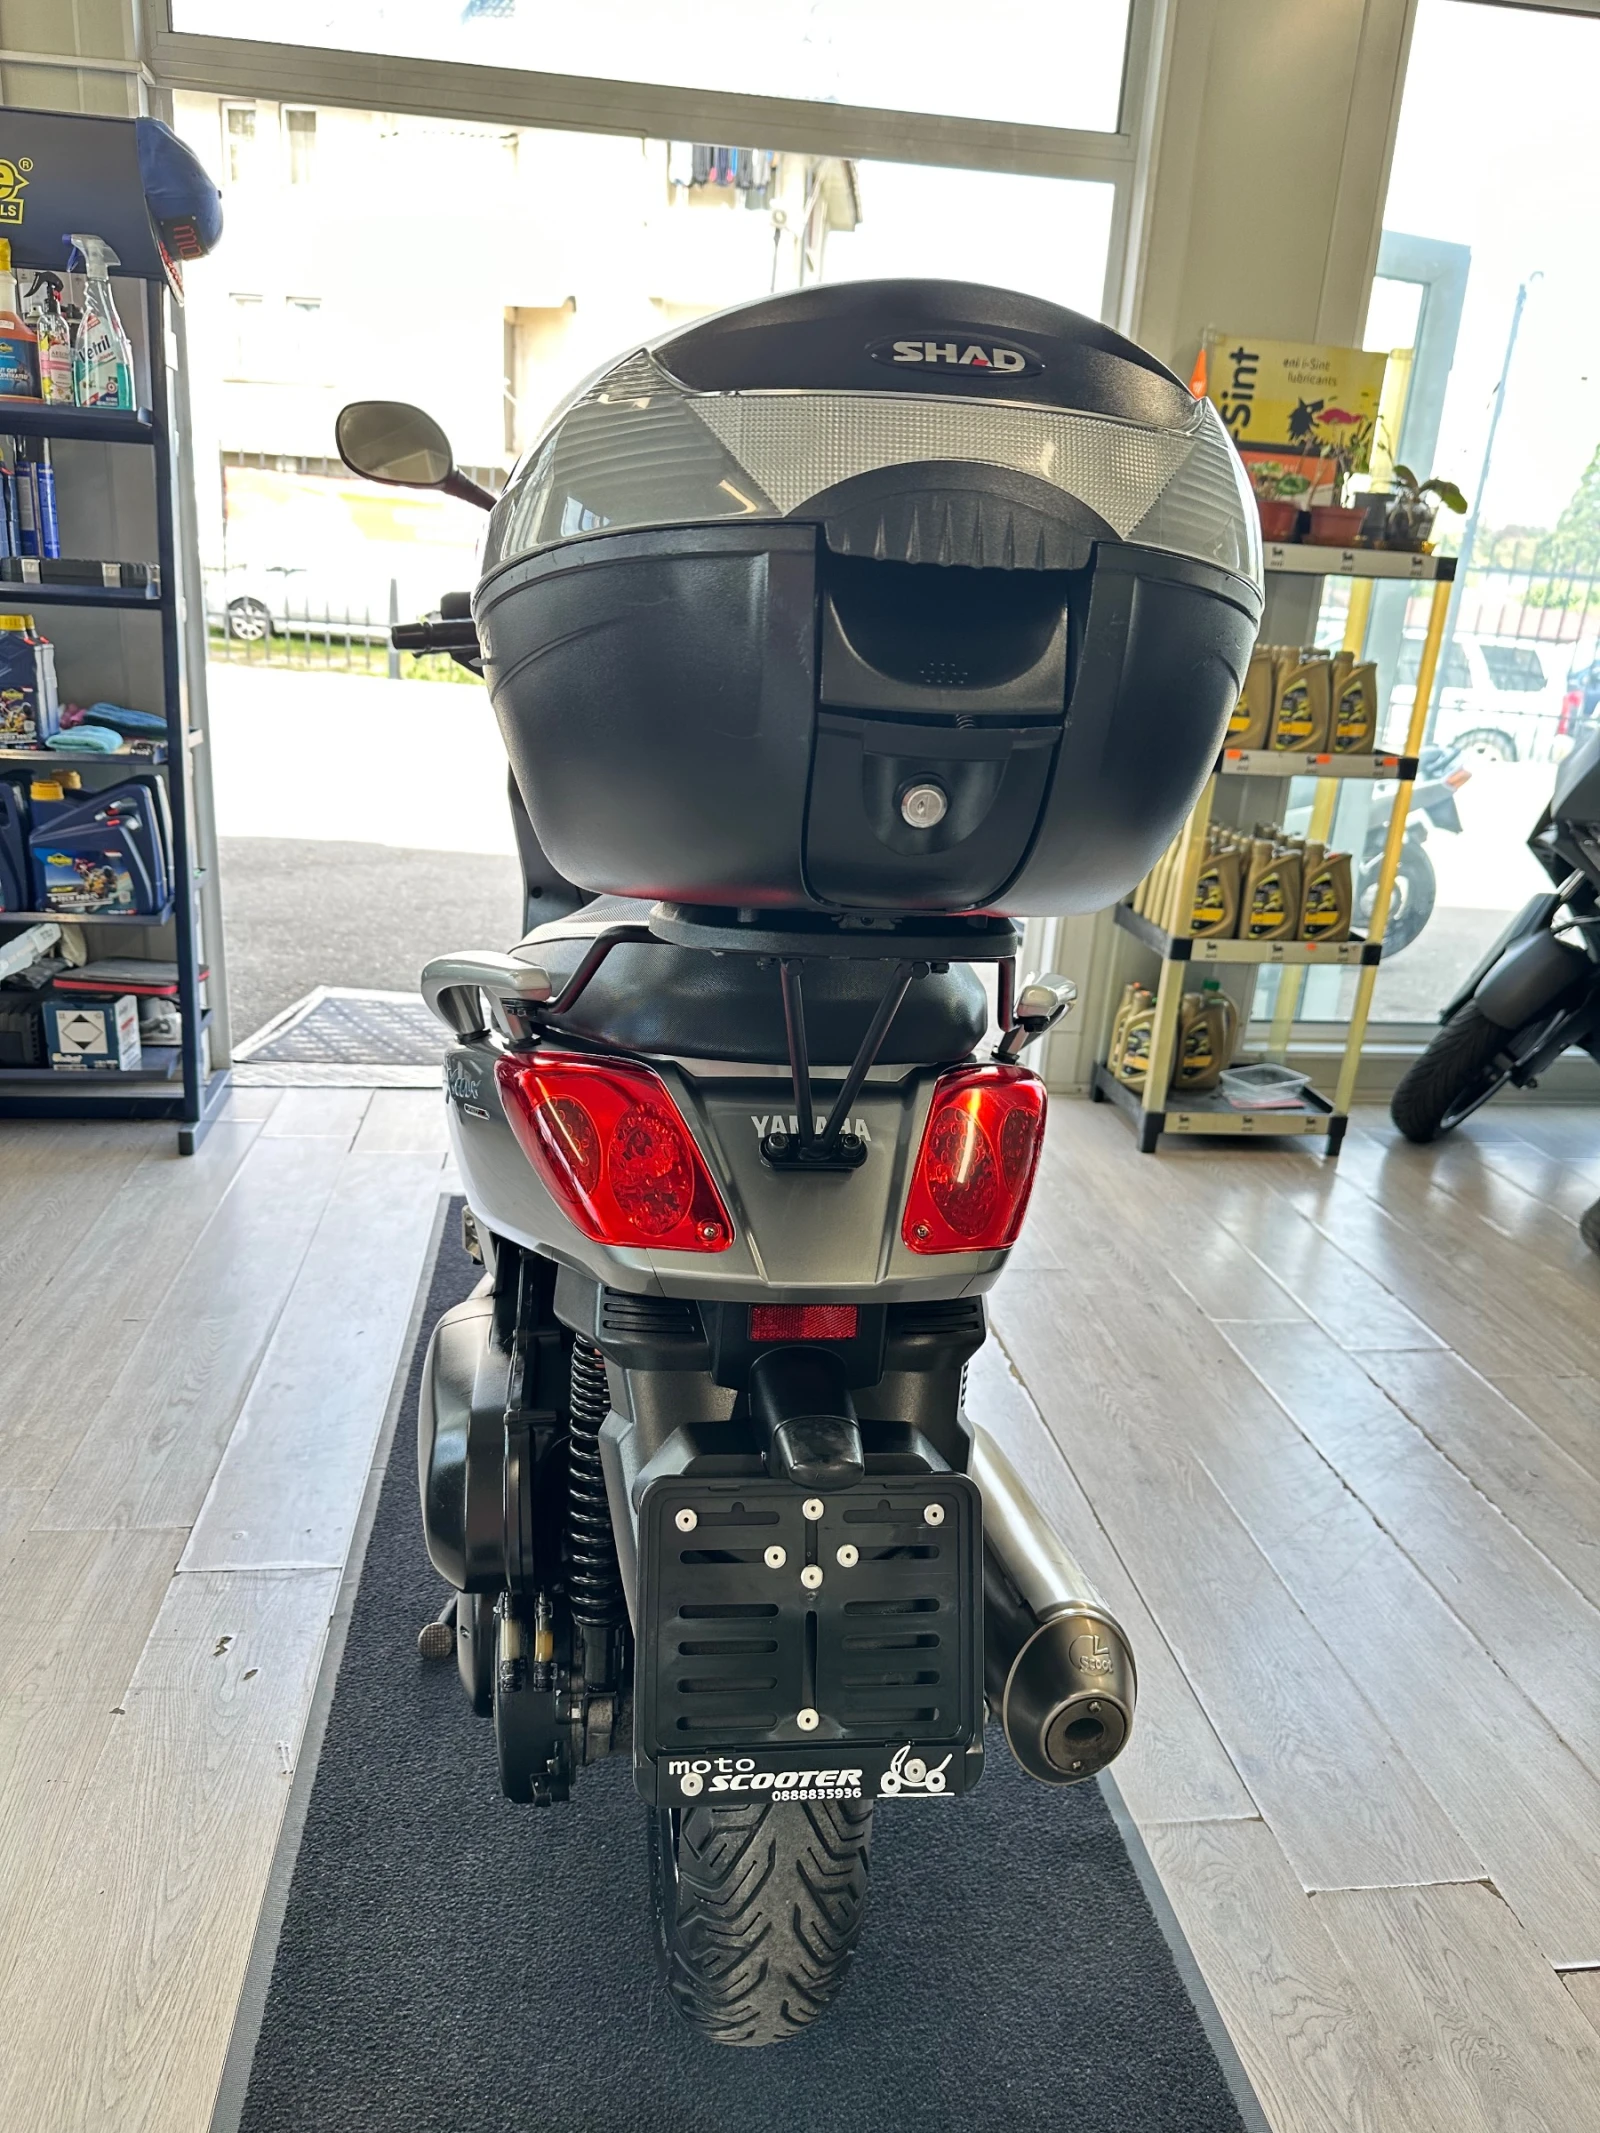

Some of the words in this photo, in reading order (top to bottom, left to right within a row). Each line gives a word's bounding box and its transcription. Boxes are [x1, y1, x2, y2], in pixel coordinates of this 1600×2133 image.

[79, 335, 111, 363] Vetril
[893, 341, 1026, 373] SHAD
[1287, 371, 1338, 387] lubricants
[668, 1757, 756, 1775] moto
[708, 1768, 864, 1793] SCOOTER
[771, 1787, 863, 1802] 0888835936
